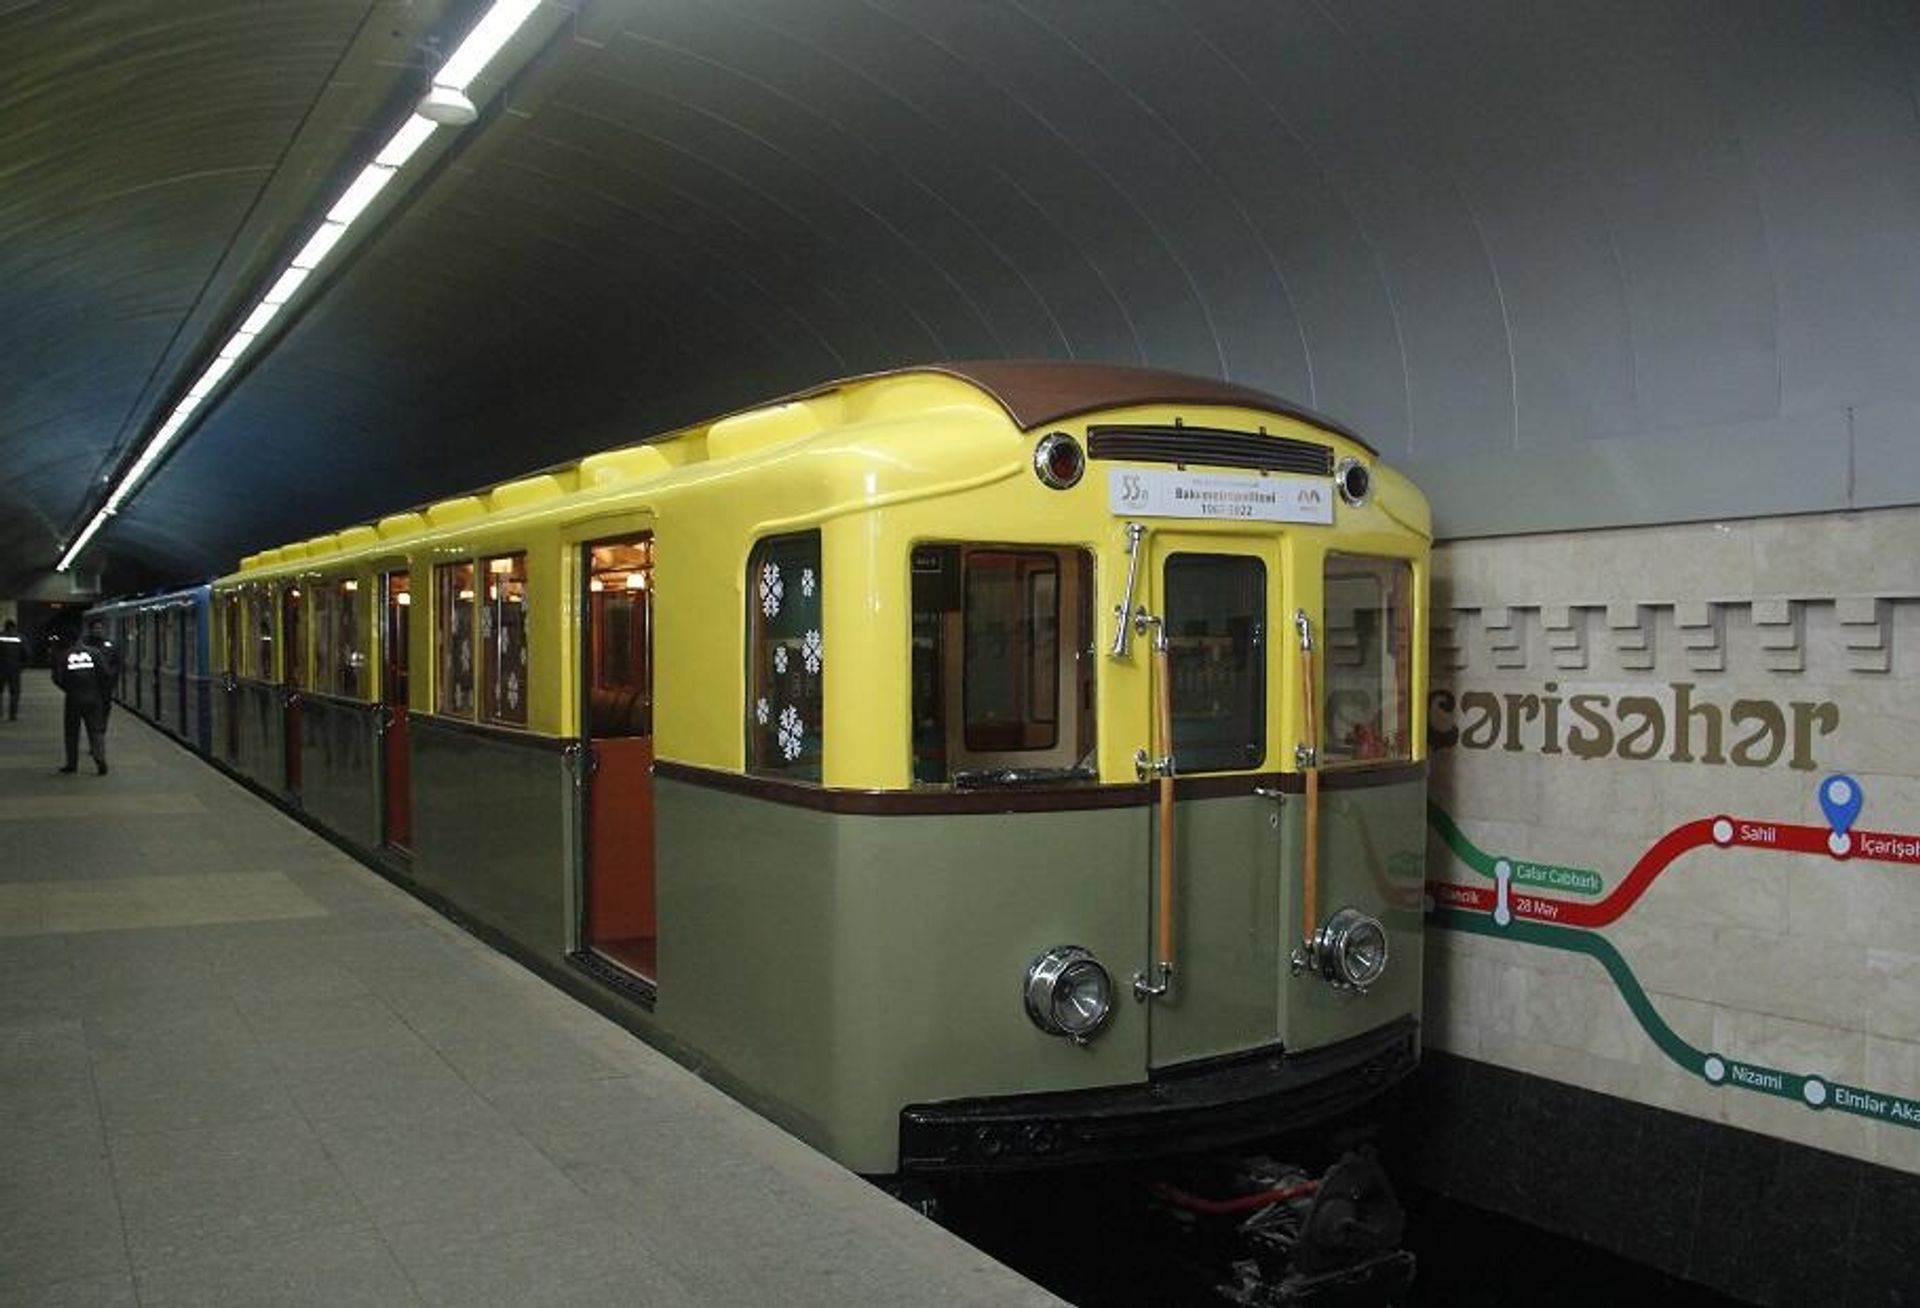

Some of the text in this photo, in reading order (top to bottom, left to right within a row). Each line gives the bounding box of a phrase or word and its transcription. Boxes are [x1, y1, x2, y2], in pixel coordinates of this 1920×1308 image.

[1740, 824, 1776, 842] Sahil
[1516, 898, 1559, 919] 28 May
[1732, 1065, 1782, 1090] Nizami
